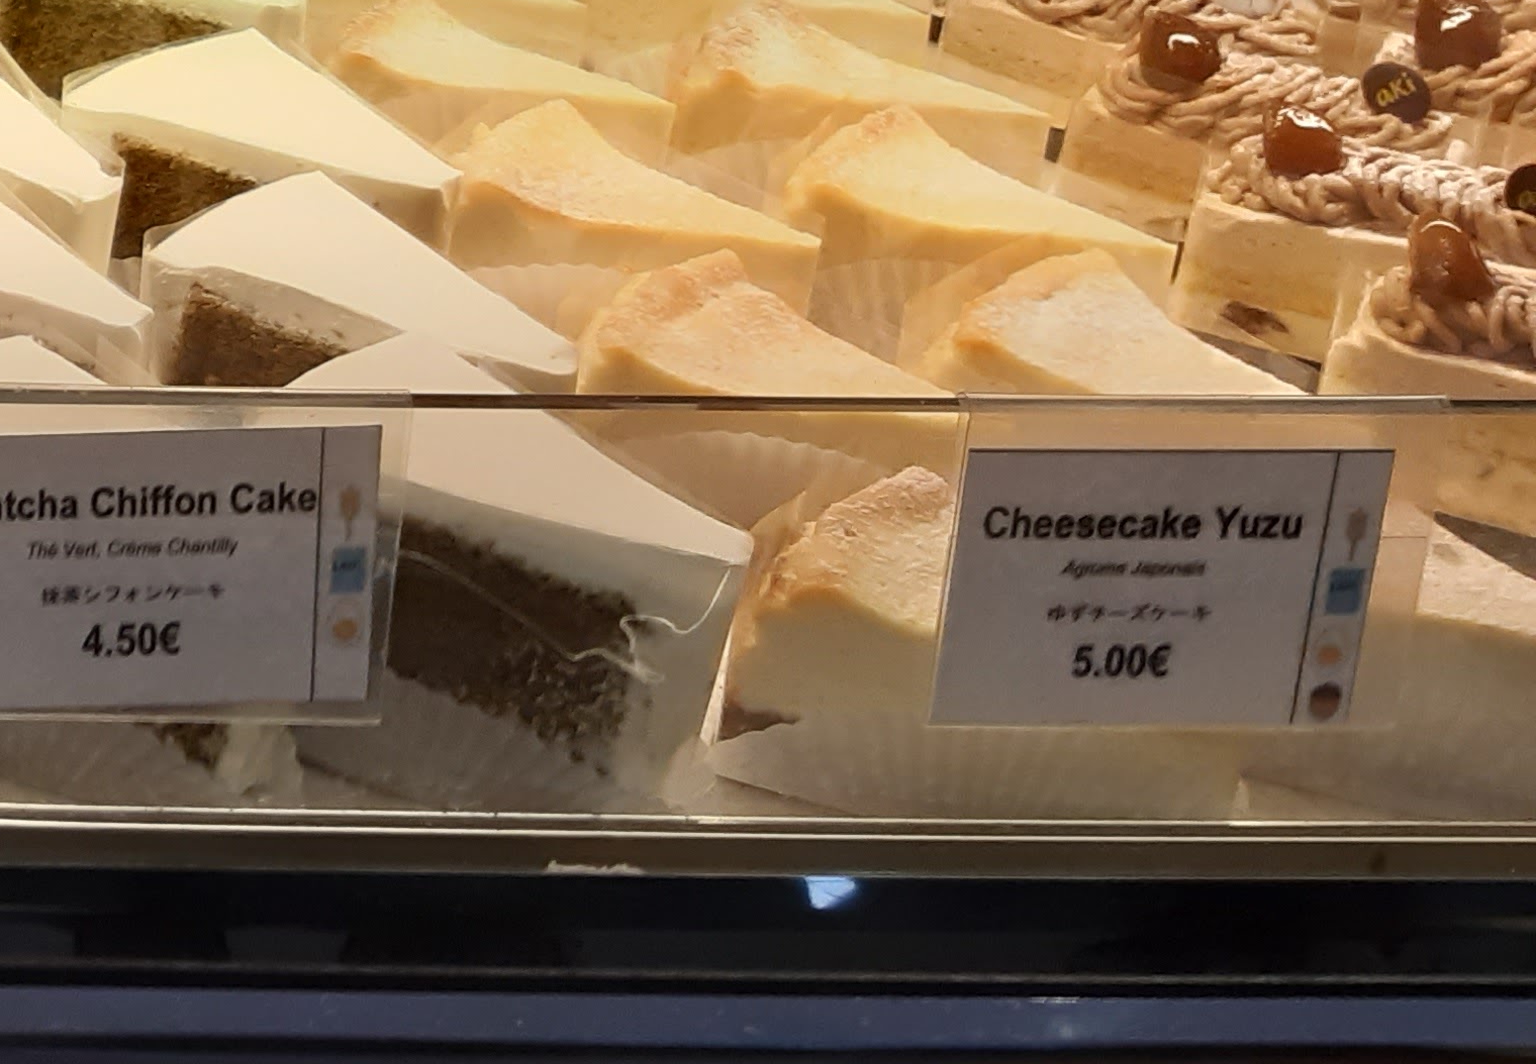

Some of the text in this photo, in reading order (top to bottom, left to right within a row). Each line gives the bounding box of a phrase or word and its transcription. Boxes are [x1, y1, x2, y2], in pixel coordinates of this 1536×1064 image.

[90, 484, 217, 518] Chiffon
[230, 481, 318, 515] Cake
[983, 504, 1305, 540] Cheesecake Yuzu
[27, 542, 58, 560] Thé
[167, 537, 239, 558] Chantilly
[81, 620, 182, 658] 4.50€
[1071, 642, 1173, 679] 5.00€
